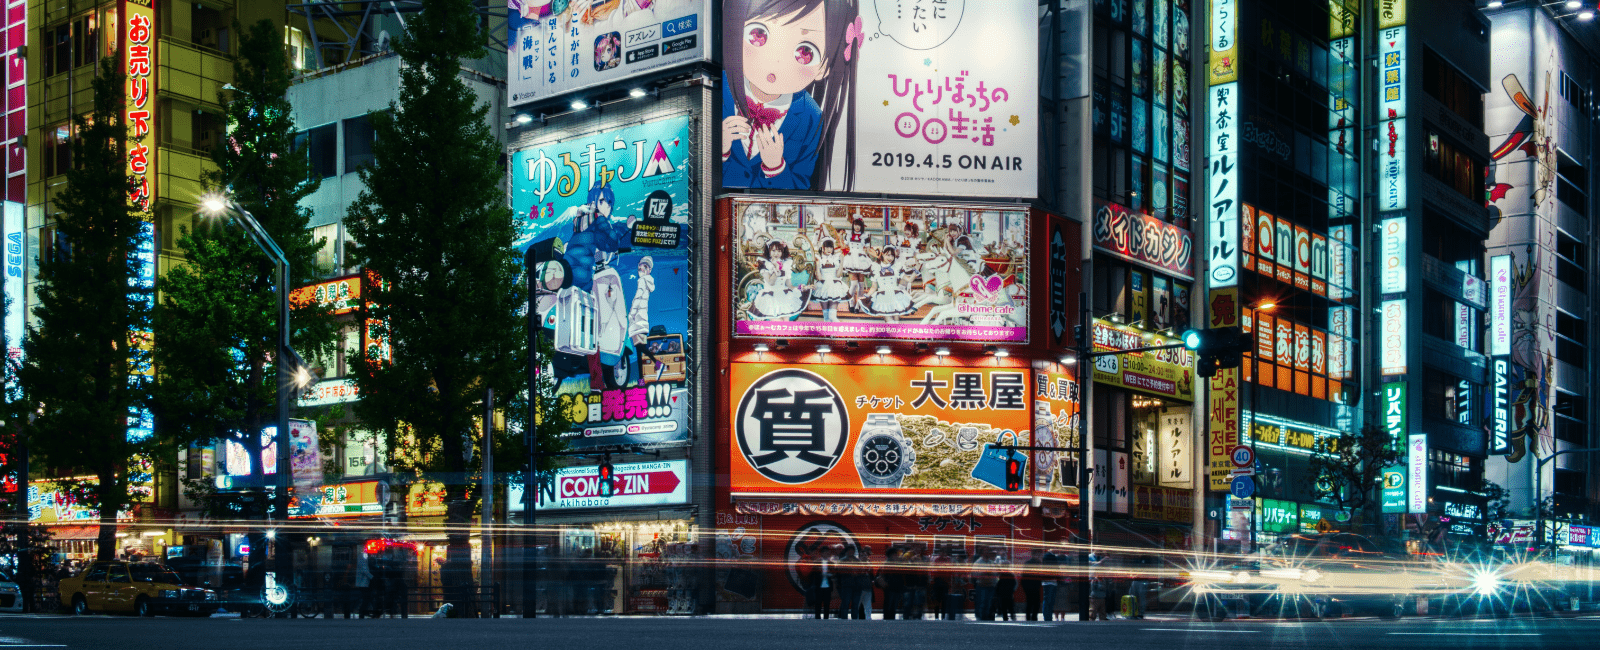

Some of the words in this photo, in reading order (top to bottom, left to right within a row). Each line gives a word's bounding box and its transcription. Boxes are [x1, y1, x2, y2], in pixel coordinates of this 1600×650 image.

[628, 28, 656, 44] アズレン
[678, 18, 692, 30] 検索
[1219, 0, 1229, 49] らくる
[1386, 29, 1400, 40] 5F
[548, 17, 557, 85] 望んでいる
[571, 12, 580, 79] これが君の
[1385, 52, 1400, 102] 秋葉館
[887, 70, 1009, 112] ひとりぼっちの
[1111, 111, 1127, 141] 5F
[871, 151, 952, 169] 2019.4.5
[957, 154, 988, 171] ON
[990, 155, 1023, 171] AIR
[1094, 206, 1191, 270] メイドカジノ
[7, 231, 22, 278] SEGA
[1388, 221, 1400, 291] amiami
[957, 302, 993, 315] @home
[910, 370, 1026, 411] 大黒屋
[1124, 374, 1138, 384] WEB
[588, 394, 601, 404] FRI
[855, 395, 905, 411] チケット
[1495, 360, 1507, 450] GALLERIA
[751, 386, 837, 470] 質
[1170, 427, 1183, 479] ルノアール
[1235, 451, 1249, 462] 40
[561, 475, 620, 498] COMC
[623, 474, 650, 494] ZIN
[1235, 481, 1245, 496] P
[560, 498, 610, 508] Akihabara
[918, 516, 982, 532] チケット
[1264, 508, 1297, 525] リバティー
